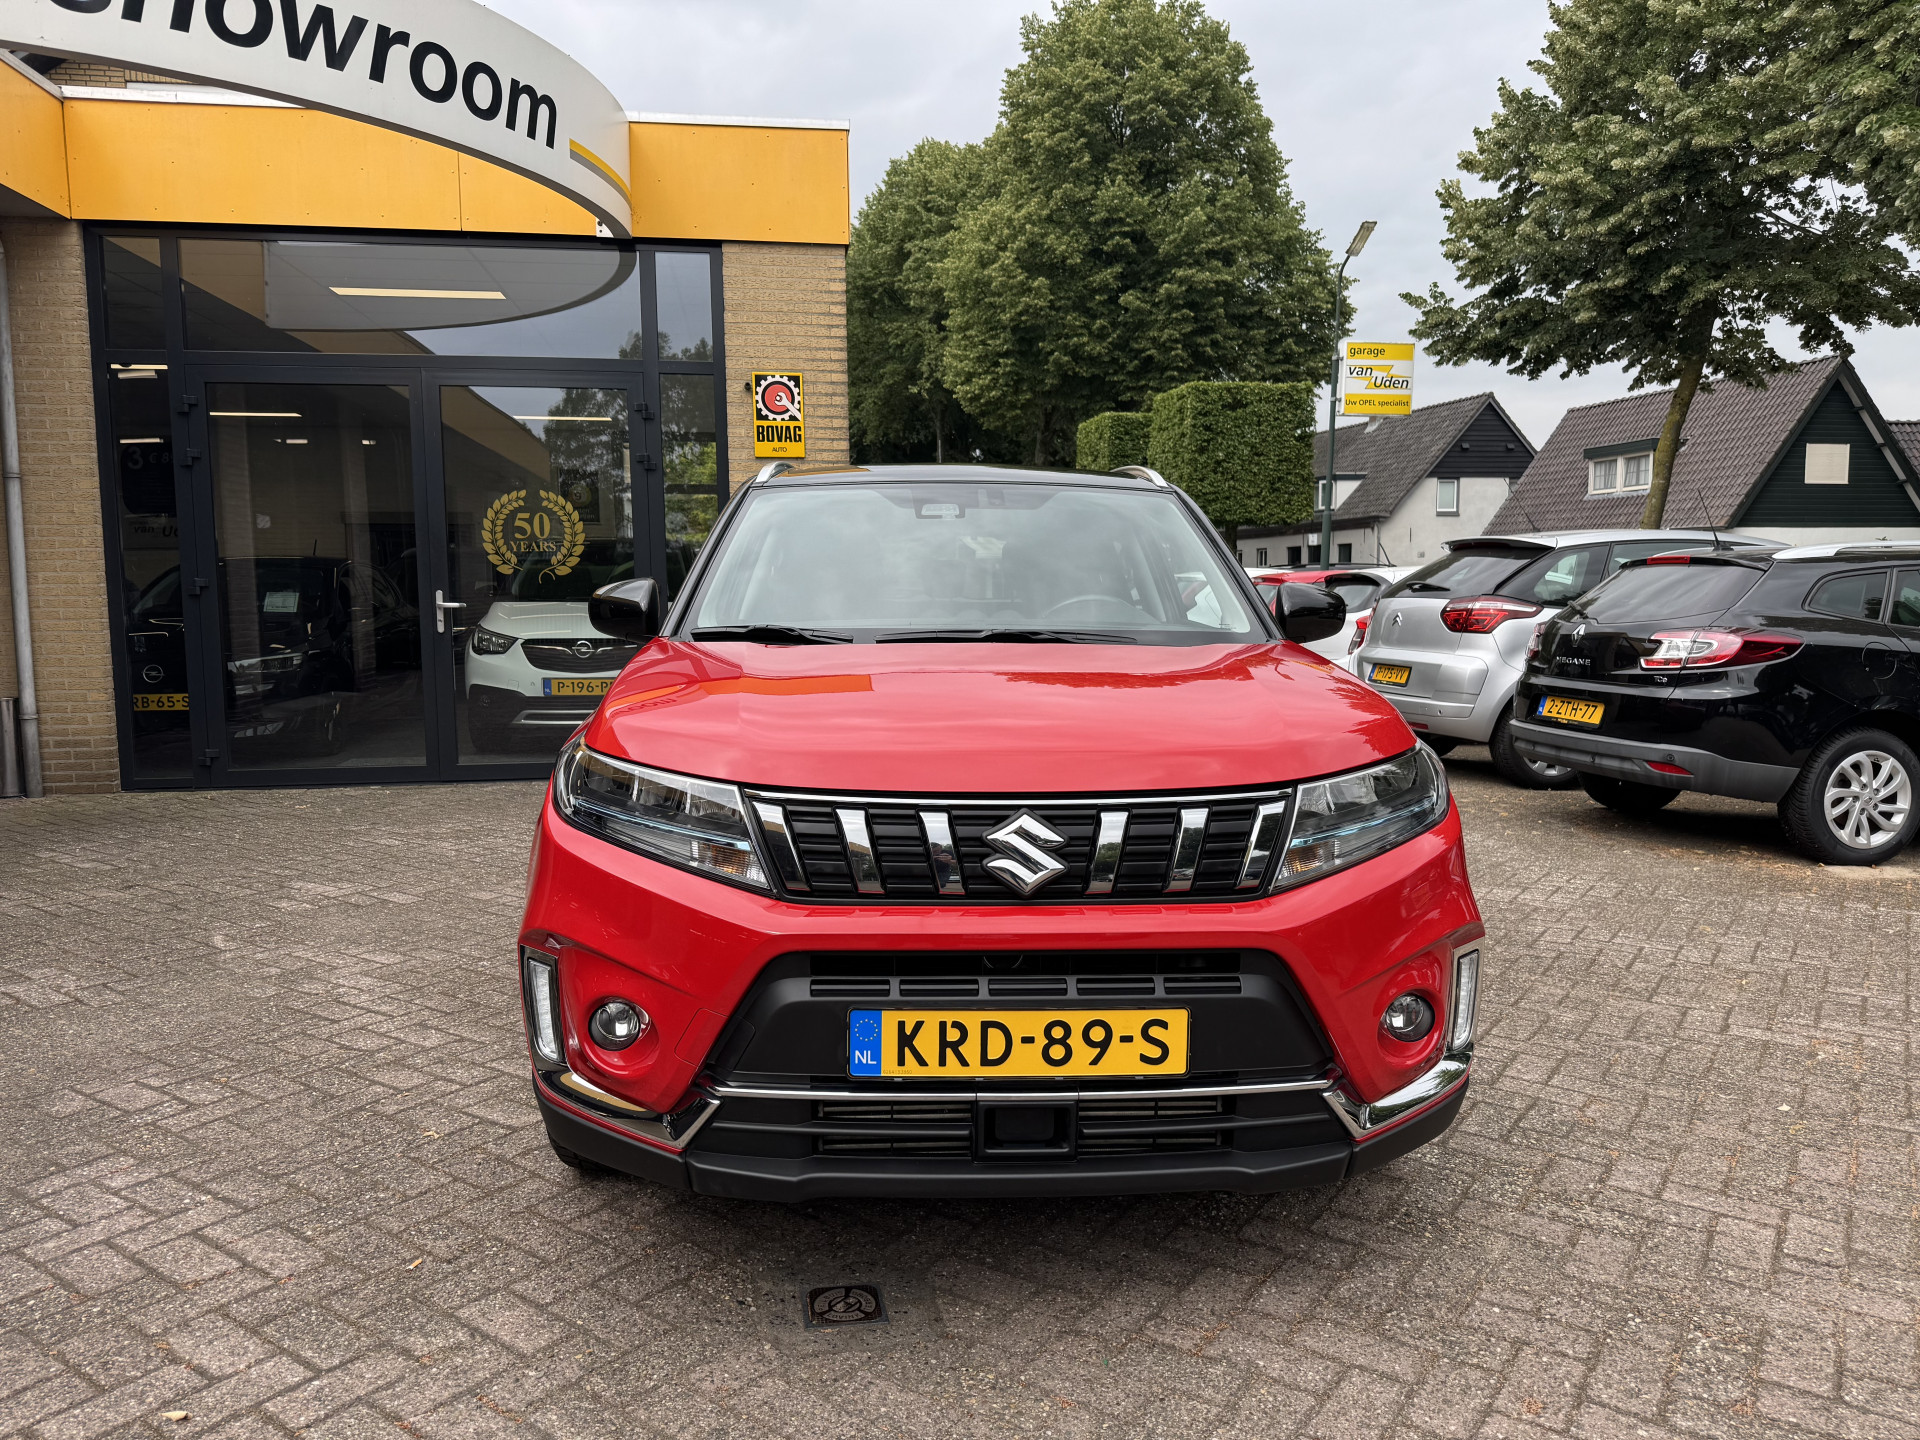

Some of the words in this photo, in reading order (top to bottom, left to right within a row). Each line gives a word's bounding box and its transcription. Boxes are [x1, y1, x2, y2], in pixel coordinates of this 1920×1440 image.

[51, 0, 557, 150] owroom
[1349, 347, 1386, 357] garage
[1348, 366, 1373, 376] van
[1373, 376, 1409, 389] Uden
[1377, 399, 1409, 407] specialist
[756, 425, 802, 443] BOVAG
[514, 512, 550, 539] 50
[510, 540, 556, 552] YEARS
[557, 681, 613, 694] P-196-P
[1547, 698, 1598, 721] 2-ZTH-77
[896, 1018, 1170, 1068] KRD-89-S
[854, 1050, 877, 1065] NL
